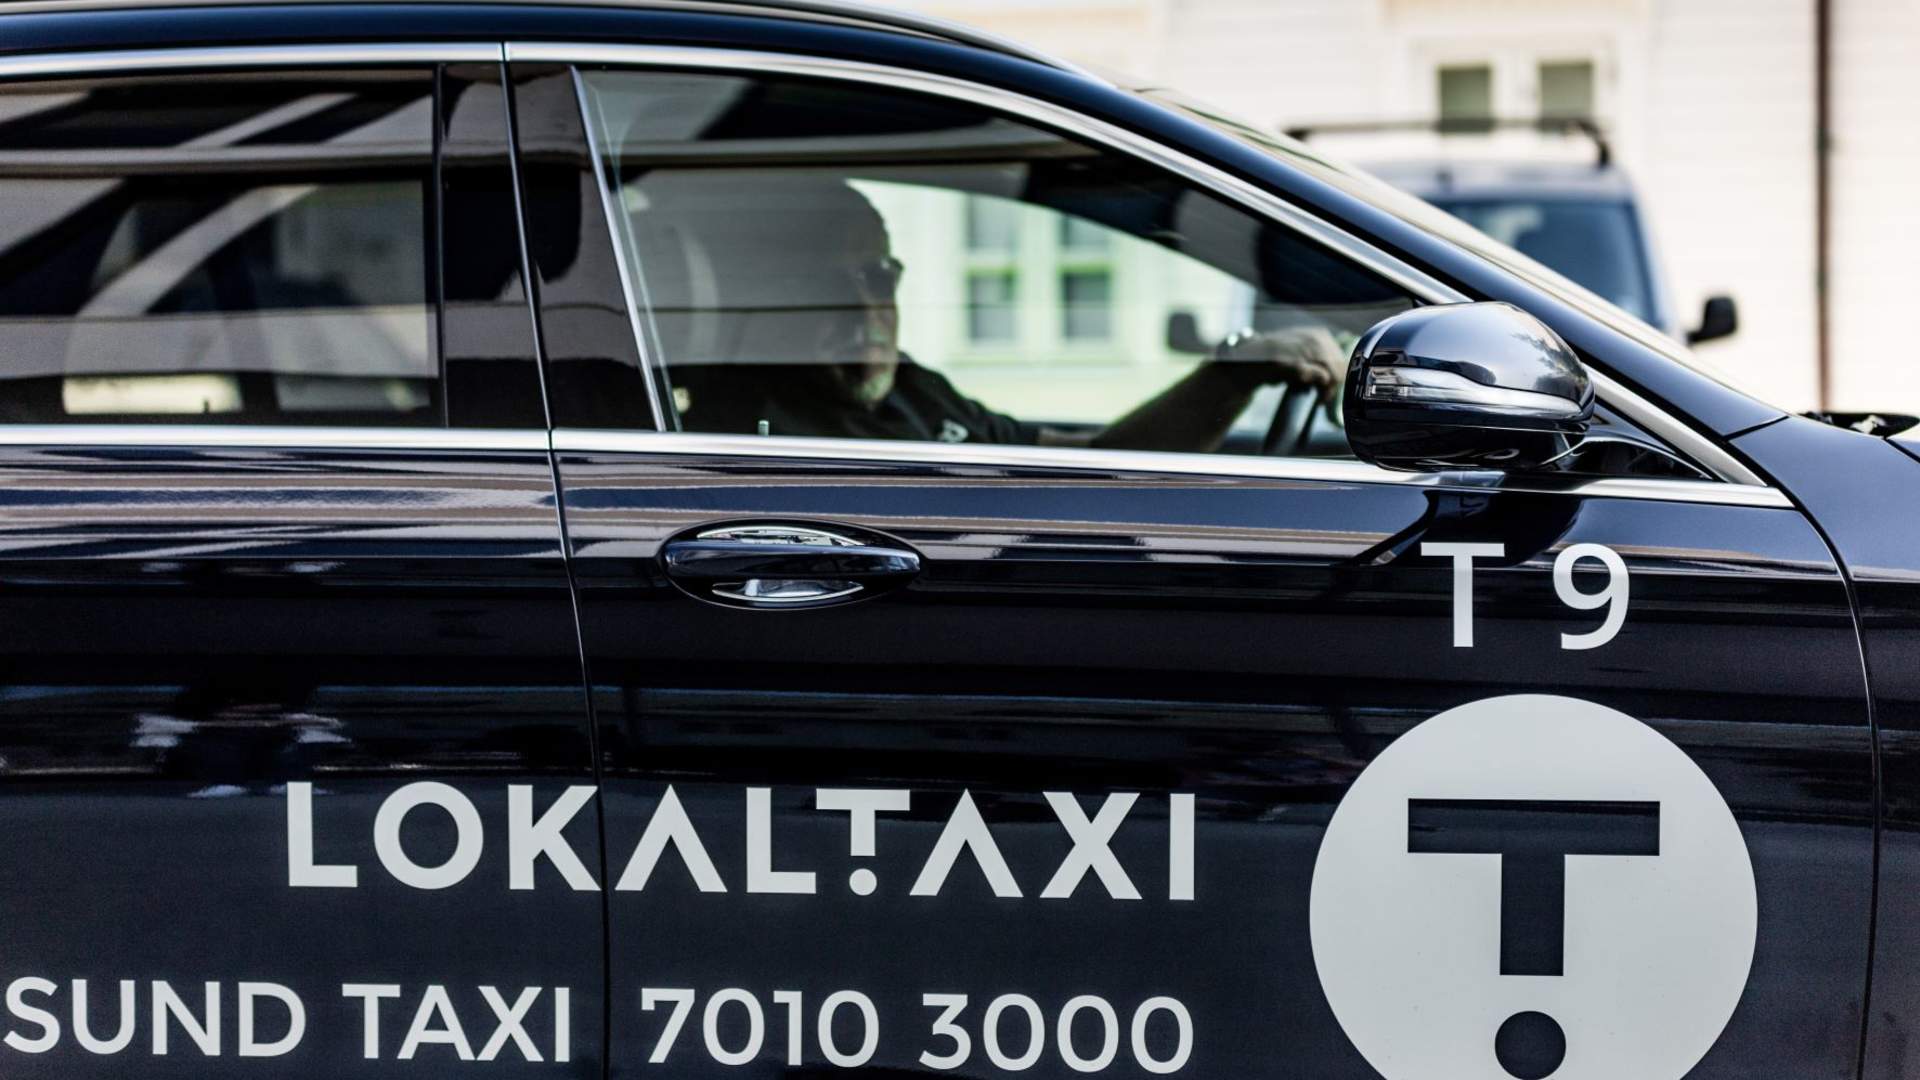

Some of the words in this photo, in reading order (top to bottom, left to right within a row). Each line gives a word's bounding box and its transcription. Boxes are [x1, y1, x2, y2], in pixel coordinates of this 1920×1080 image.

[1421, 542, 1504, 648] T
[1553, 542, 1630, 650] 9
[287, 781, 1195, 900] LOKALTAXI
[4, 976, 306, 1057] SUND
[342, 983, 571, 1062] TAXI
[641, 987, 879, 1068] 7010
[919, 993, 1194, 1074] 3000
